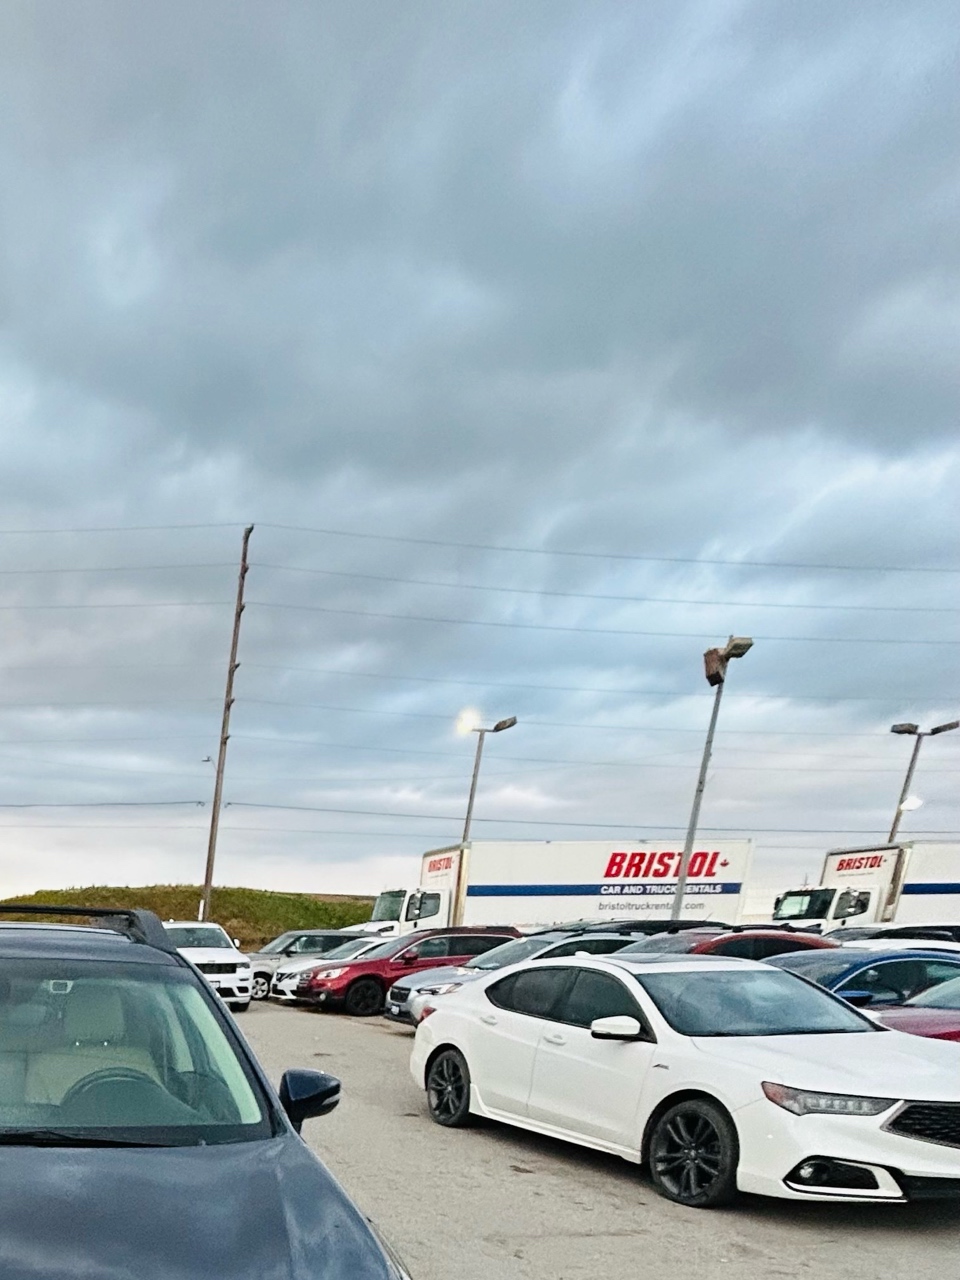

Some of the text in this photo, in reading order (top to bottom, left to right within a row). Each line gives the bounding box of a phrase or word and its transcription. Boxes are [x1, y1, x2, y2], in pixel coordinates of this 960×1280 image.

[836, 855, 883, 871] BRISTOL
[600, 884, 722, 894] CAR AND TRUCK ENTALS
